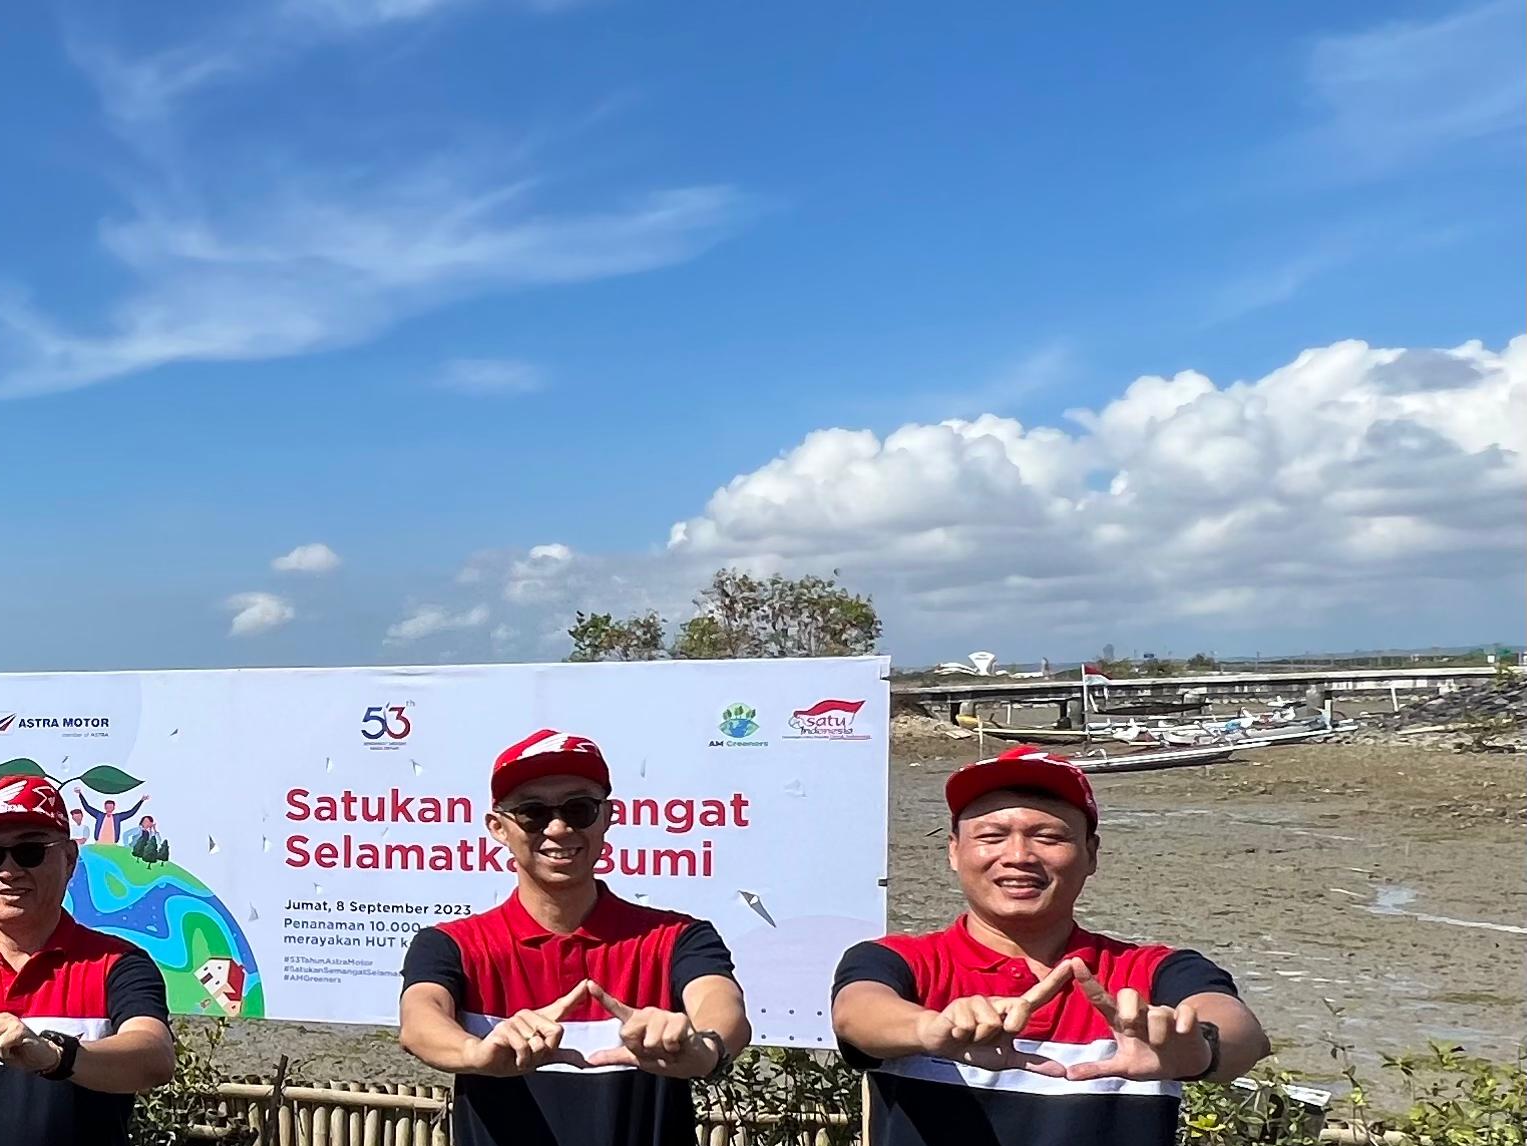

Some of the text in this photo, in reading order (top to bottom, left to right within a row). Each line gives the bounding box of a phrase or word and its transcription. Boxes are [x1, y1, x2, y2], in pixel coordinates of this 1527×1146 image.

[18, 718, 109, 729] ASTRA MOTOR
[807, 715, 846, 728] satu
[285, 788, 749, 834] Satukan angat
[285, 899, 471, 915] Jumat, 8 September 2023
[284, 918, 421, 933] Penanaman 10.000
[284, 935, 361, 947] merayakan
[366, 937, 396, 947] HUT
